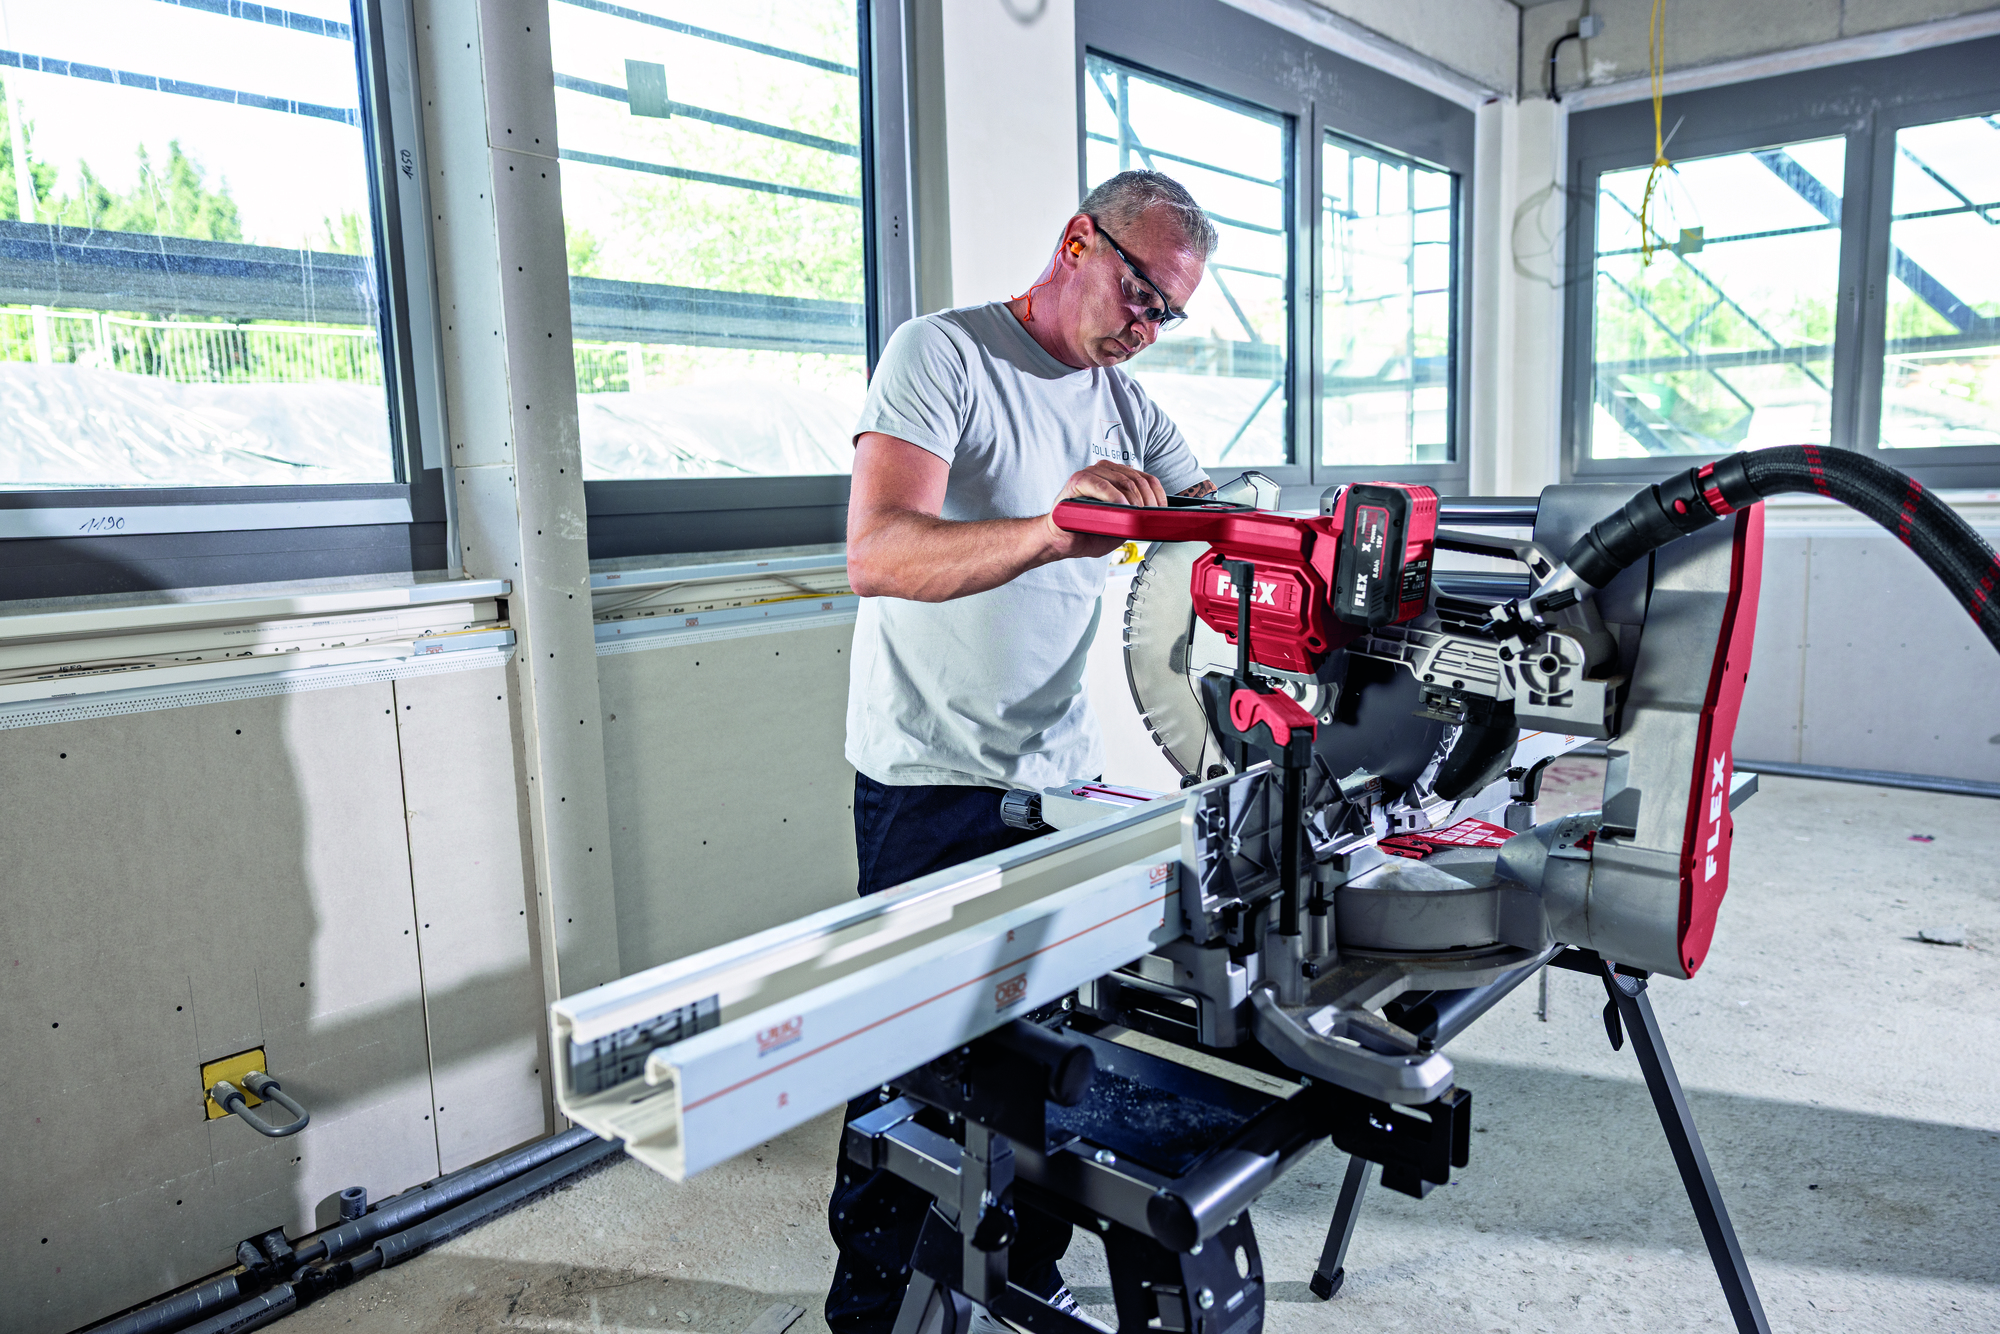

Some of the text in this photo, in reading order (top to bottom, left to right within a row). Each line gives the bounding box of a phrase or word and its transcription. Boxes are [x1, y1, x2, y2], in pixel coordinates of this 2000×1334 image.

[400, 149, 414, 180] 1450
[79, 516, 125, 533] 1190
[1372, 559, 1380, 579] 8.0Ah
[1354, 573, 1368, 607] FLEX
[1704, 751, 1726, 883] FLEX
